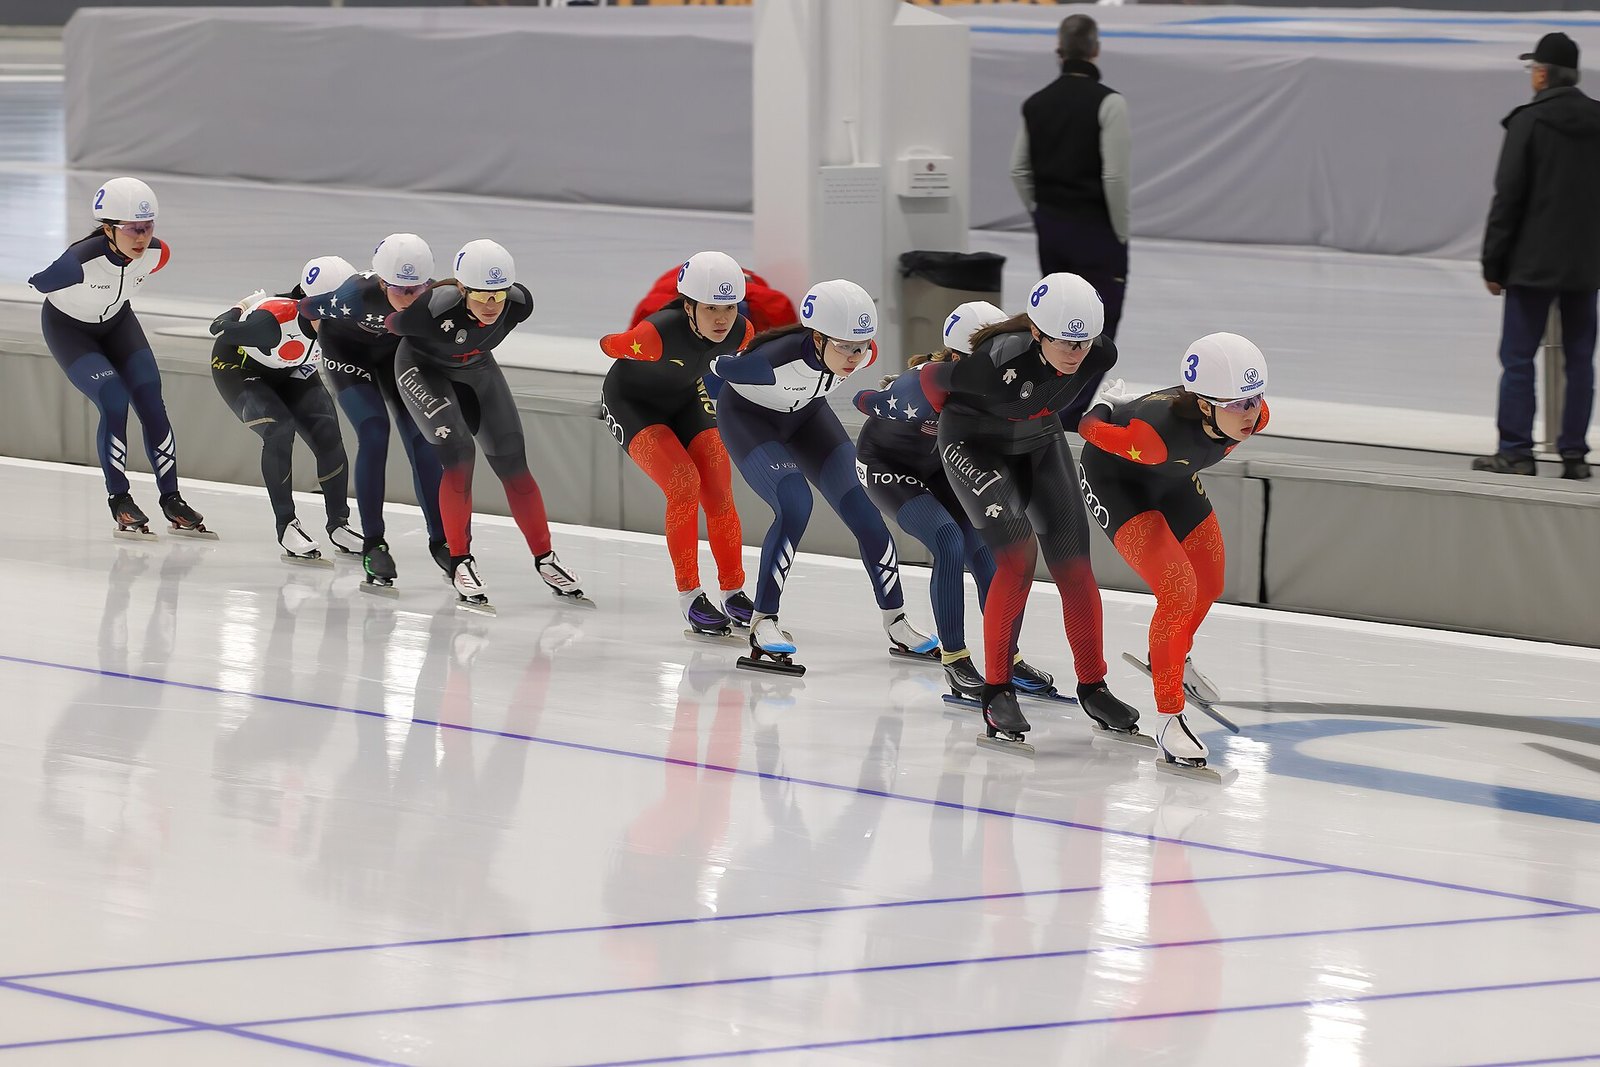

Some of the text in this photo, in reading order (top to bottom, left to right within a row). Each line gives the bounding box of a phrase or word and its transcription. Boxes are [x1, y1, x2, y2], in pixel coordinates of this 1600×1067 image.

[95, 189, 105, 210] 2
[456, 252, 465, 271] 1
[678, 261, 690, 282] 6
[306, 267, 320, 285] 9
[802, 294, 817, 319] 5
[1031, 284, 1048, 307] 8
[945, 314, 961, 337] 7
[323, 357, 372, 382] TOYOTA
[1184, 354, 1199, 382] 3
